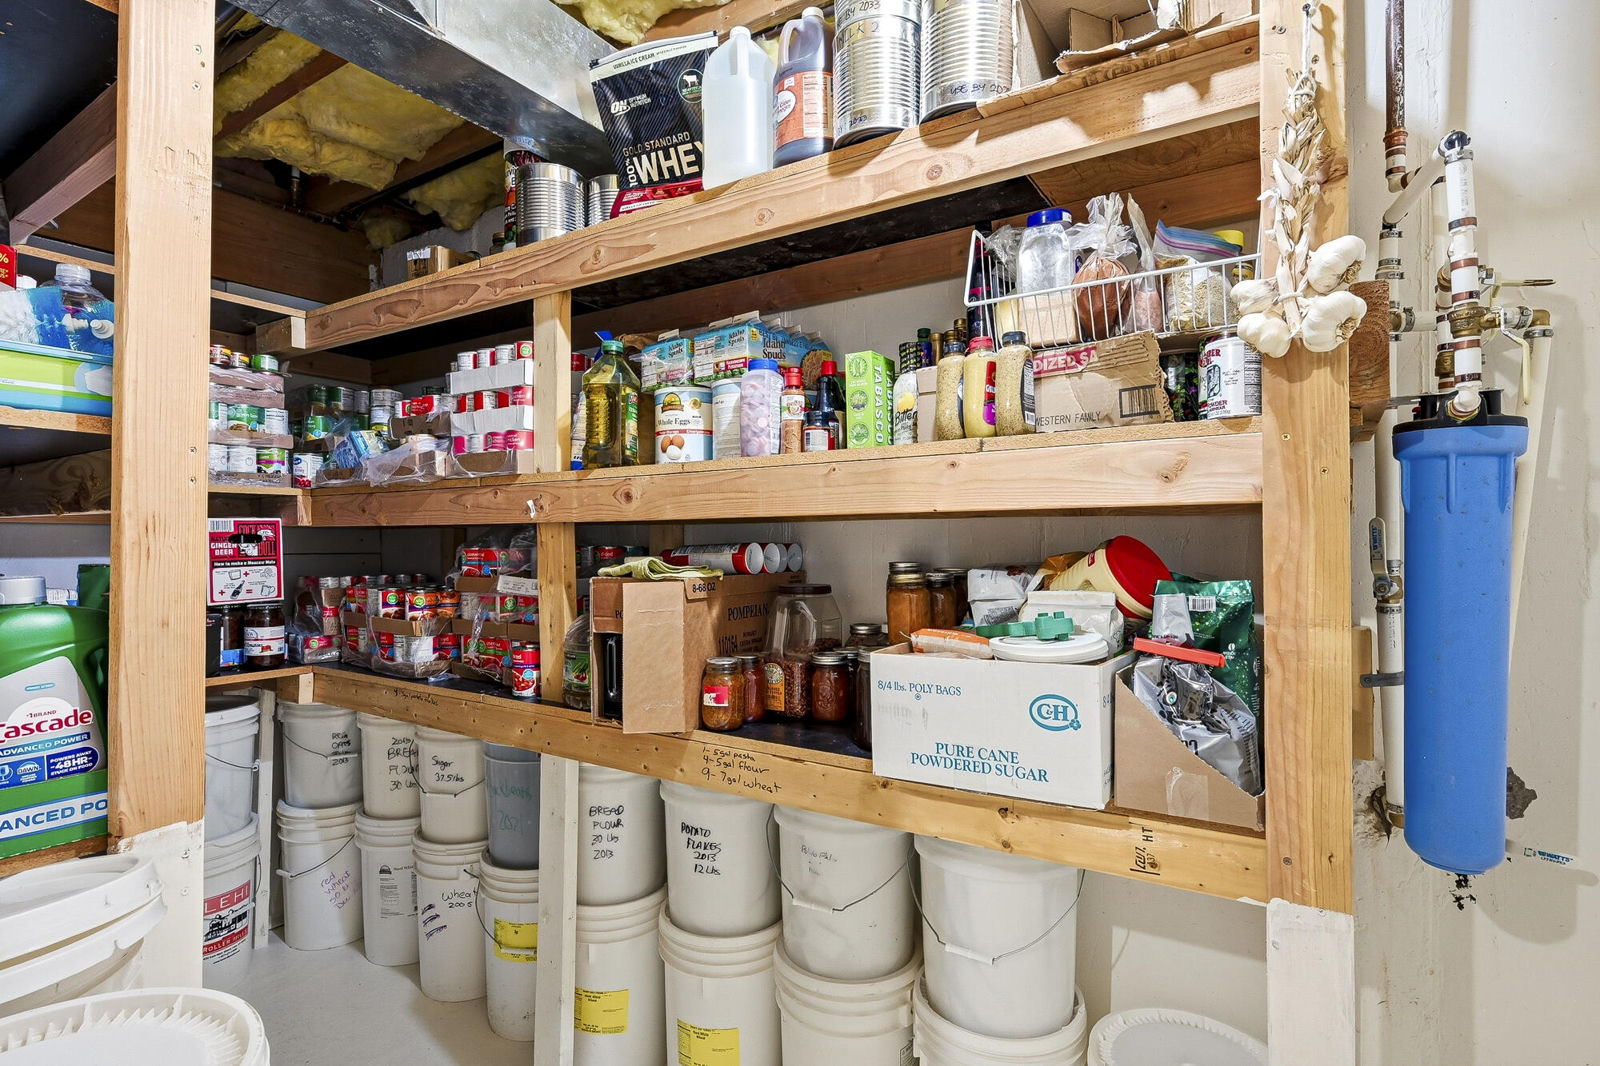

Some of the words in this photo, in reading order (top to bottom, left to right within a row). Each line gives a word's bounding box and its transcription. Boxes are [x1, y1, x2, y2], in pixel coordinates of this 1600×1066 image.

[639, 52, 656, 62] CREAM
[622, 145, 643, 157] GOLD
[644, 131, 691, 151] STANDARD
[762, 337, 786, 349] Idaho
[762, 349, 787, 360] Spuds
[873, 364, 884, 444] TABASCO
[674, 417, 691, 426] Eggs
[1074, 411, 1101, 424] FAMILY
[727, 602, 769, 621] POMPEIAN
[877, 680, 893, 691] 8/4
[893, 681, 907, 692] lbs.
[908, 682, 934, 695] POLY
[935, 684, 962, 697] BAGS
[1036, 703, 1070, 722] C&H
[54, 733, 89, 747] POWER
[733, 751, 756, 762] pasta
[935, 741, 975, 760] PURE
[977, 747, 1020, 765] CANE
[431, 755, 454, 771] Sugar
[738, 760, 770, 774] flour
[910, 751, 993, 775] POWDERED
[995, 763, 1050, 783] SUGAR
[743, 777, 782, 794] wheat
[588, 804, 625, 817] BREAD
[680, 821, 711, 838] POTATO
[686, 837, 722, 854] FLAKES
[693, 863, 704, 873] 12
[204, 885, 249, 914] LEHI
[441, 887, 477, 902] Wheat
[203, 938, 231, 953] ROLLER
